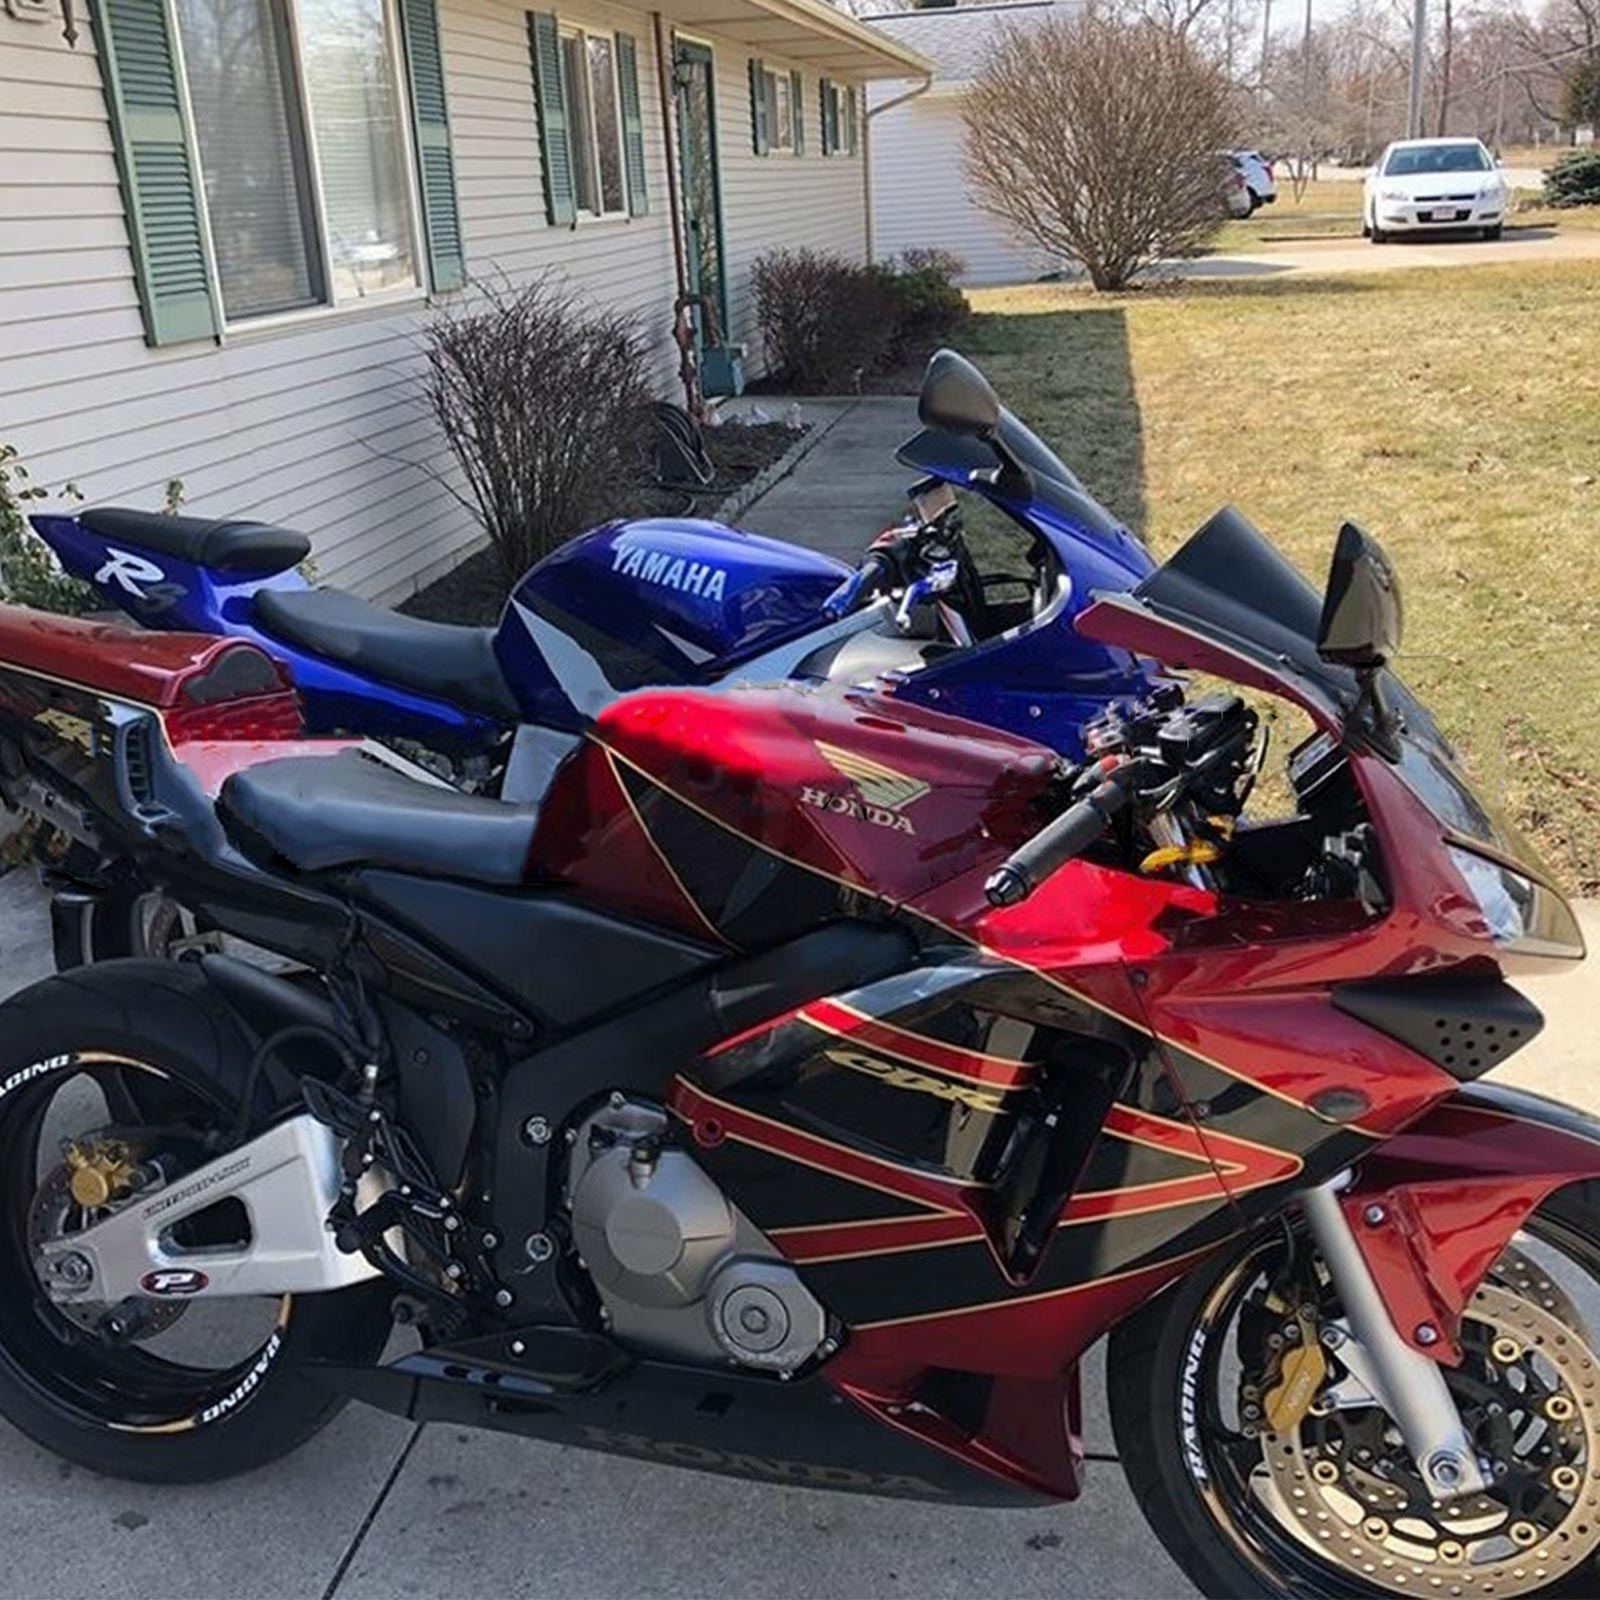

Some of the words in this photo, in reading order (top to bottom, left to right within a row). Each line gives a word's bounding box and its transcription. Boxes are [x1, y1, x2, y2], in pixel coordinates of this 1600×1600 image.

[611, 544, 727, 602] YAMAHA
[800, 787, 916, 836] HONDA
[824, 1050, 1010, 1115] CBR
[202, 1333, 281, 1423] RACING
[1181, 1328, 1208, 1479] RACING
[574, 1423, 953, 1496] HONDA
